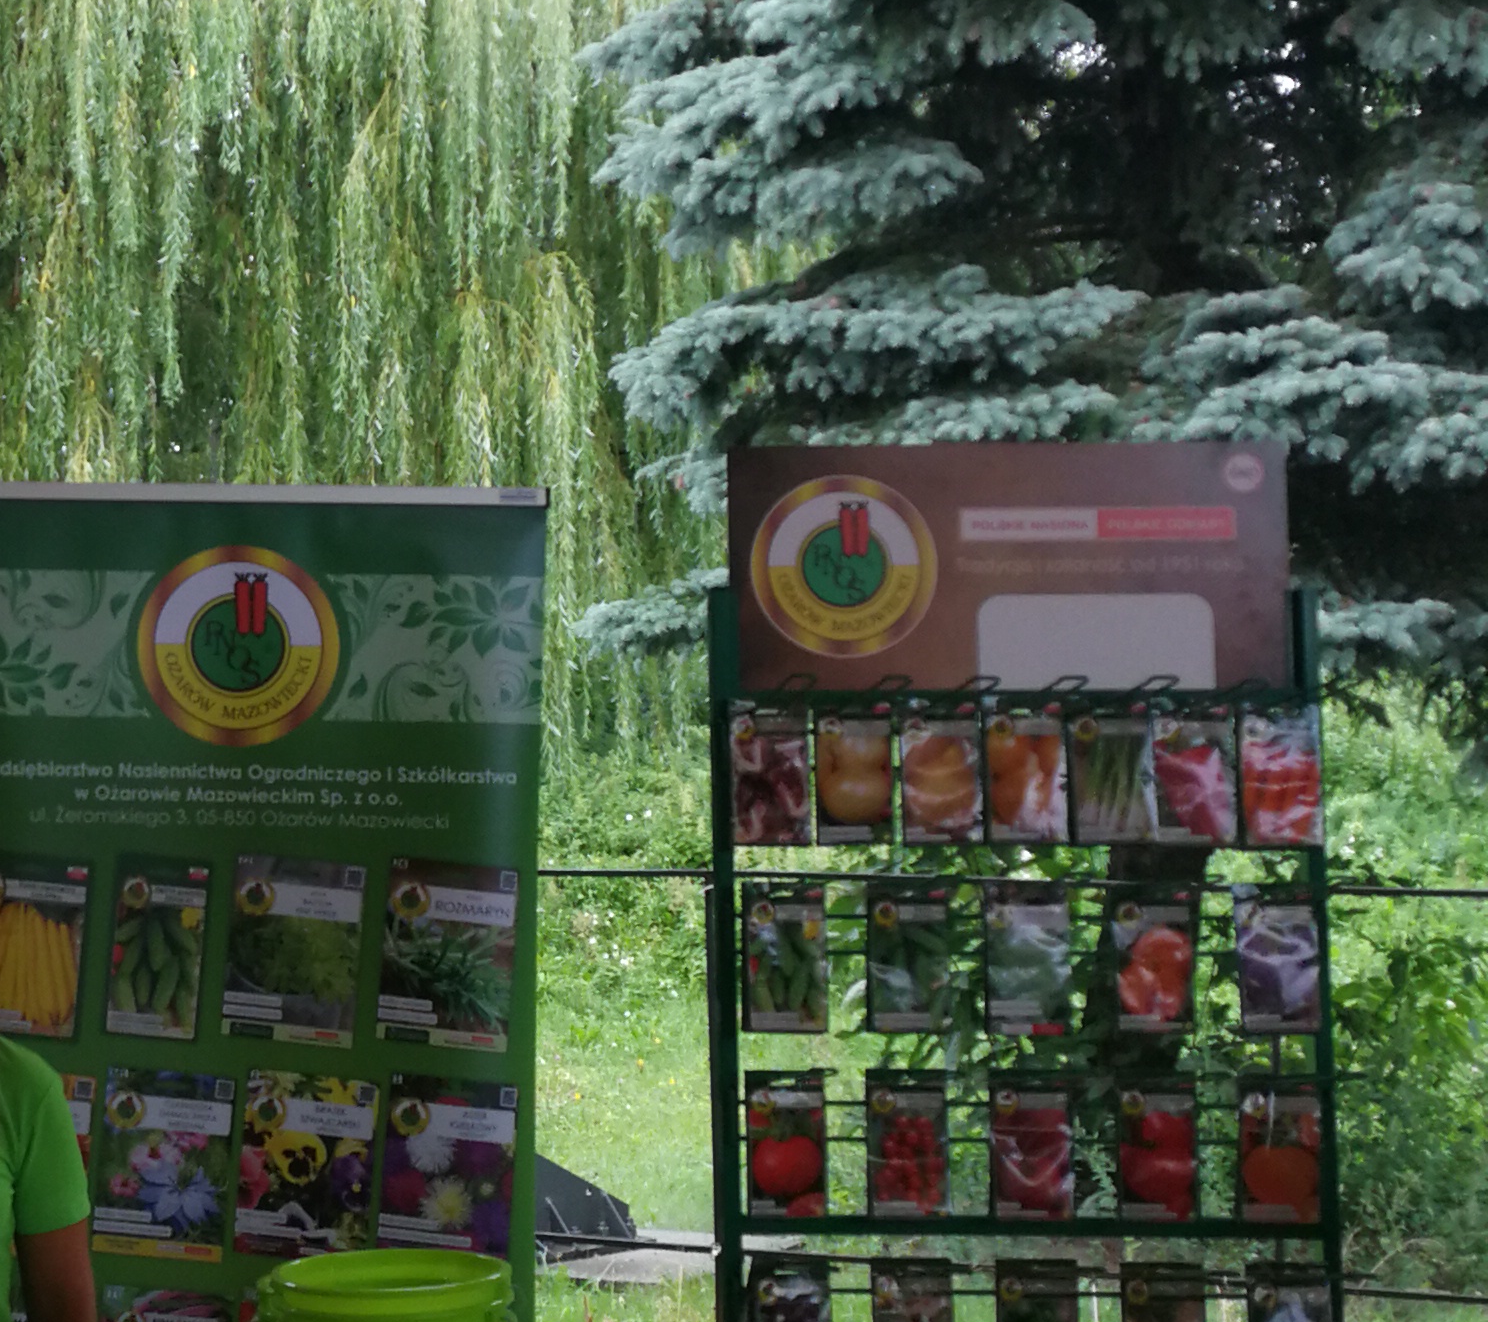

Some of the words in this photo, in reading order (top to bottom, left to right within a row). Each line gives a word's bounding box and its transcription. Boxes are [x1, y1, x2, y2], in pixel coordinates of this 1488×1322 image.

[205, 620, 261, 685] PNOS
[118, 762, 242, 780] Nasiennictwa
[248, 763, 382, 785] Ogrodniczego
[397, 765, 518, 785] Szkółkarstwa
[74, 787, 89, 801] w
[94, 784, 181, 802] Ożarowie
[186, 786, 315, 804] Mazowieckim
[320, 788, 348, 808] Sp.
[353, 792, 363, 805] z
[368, 792, 403, 806] o.o.
[28, 806, 50, 823] ul.
[196, 808, 256, 826] 05-850
[338, 812, 450, 830] Mazowiecki
[435, 899, 510, 919] ROZMARYN
